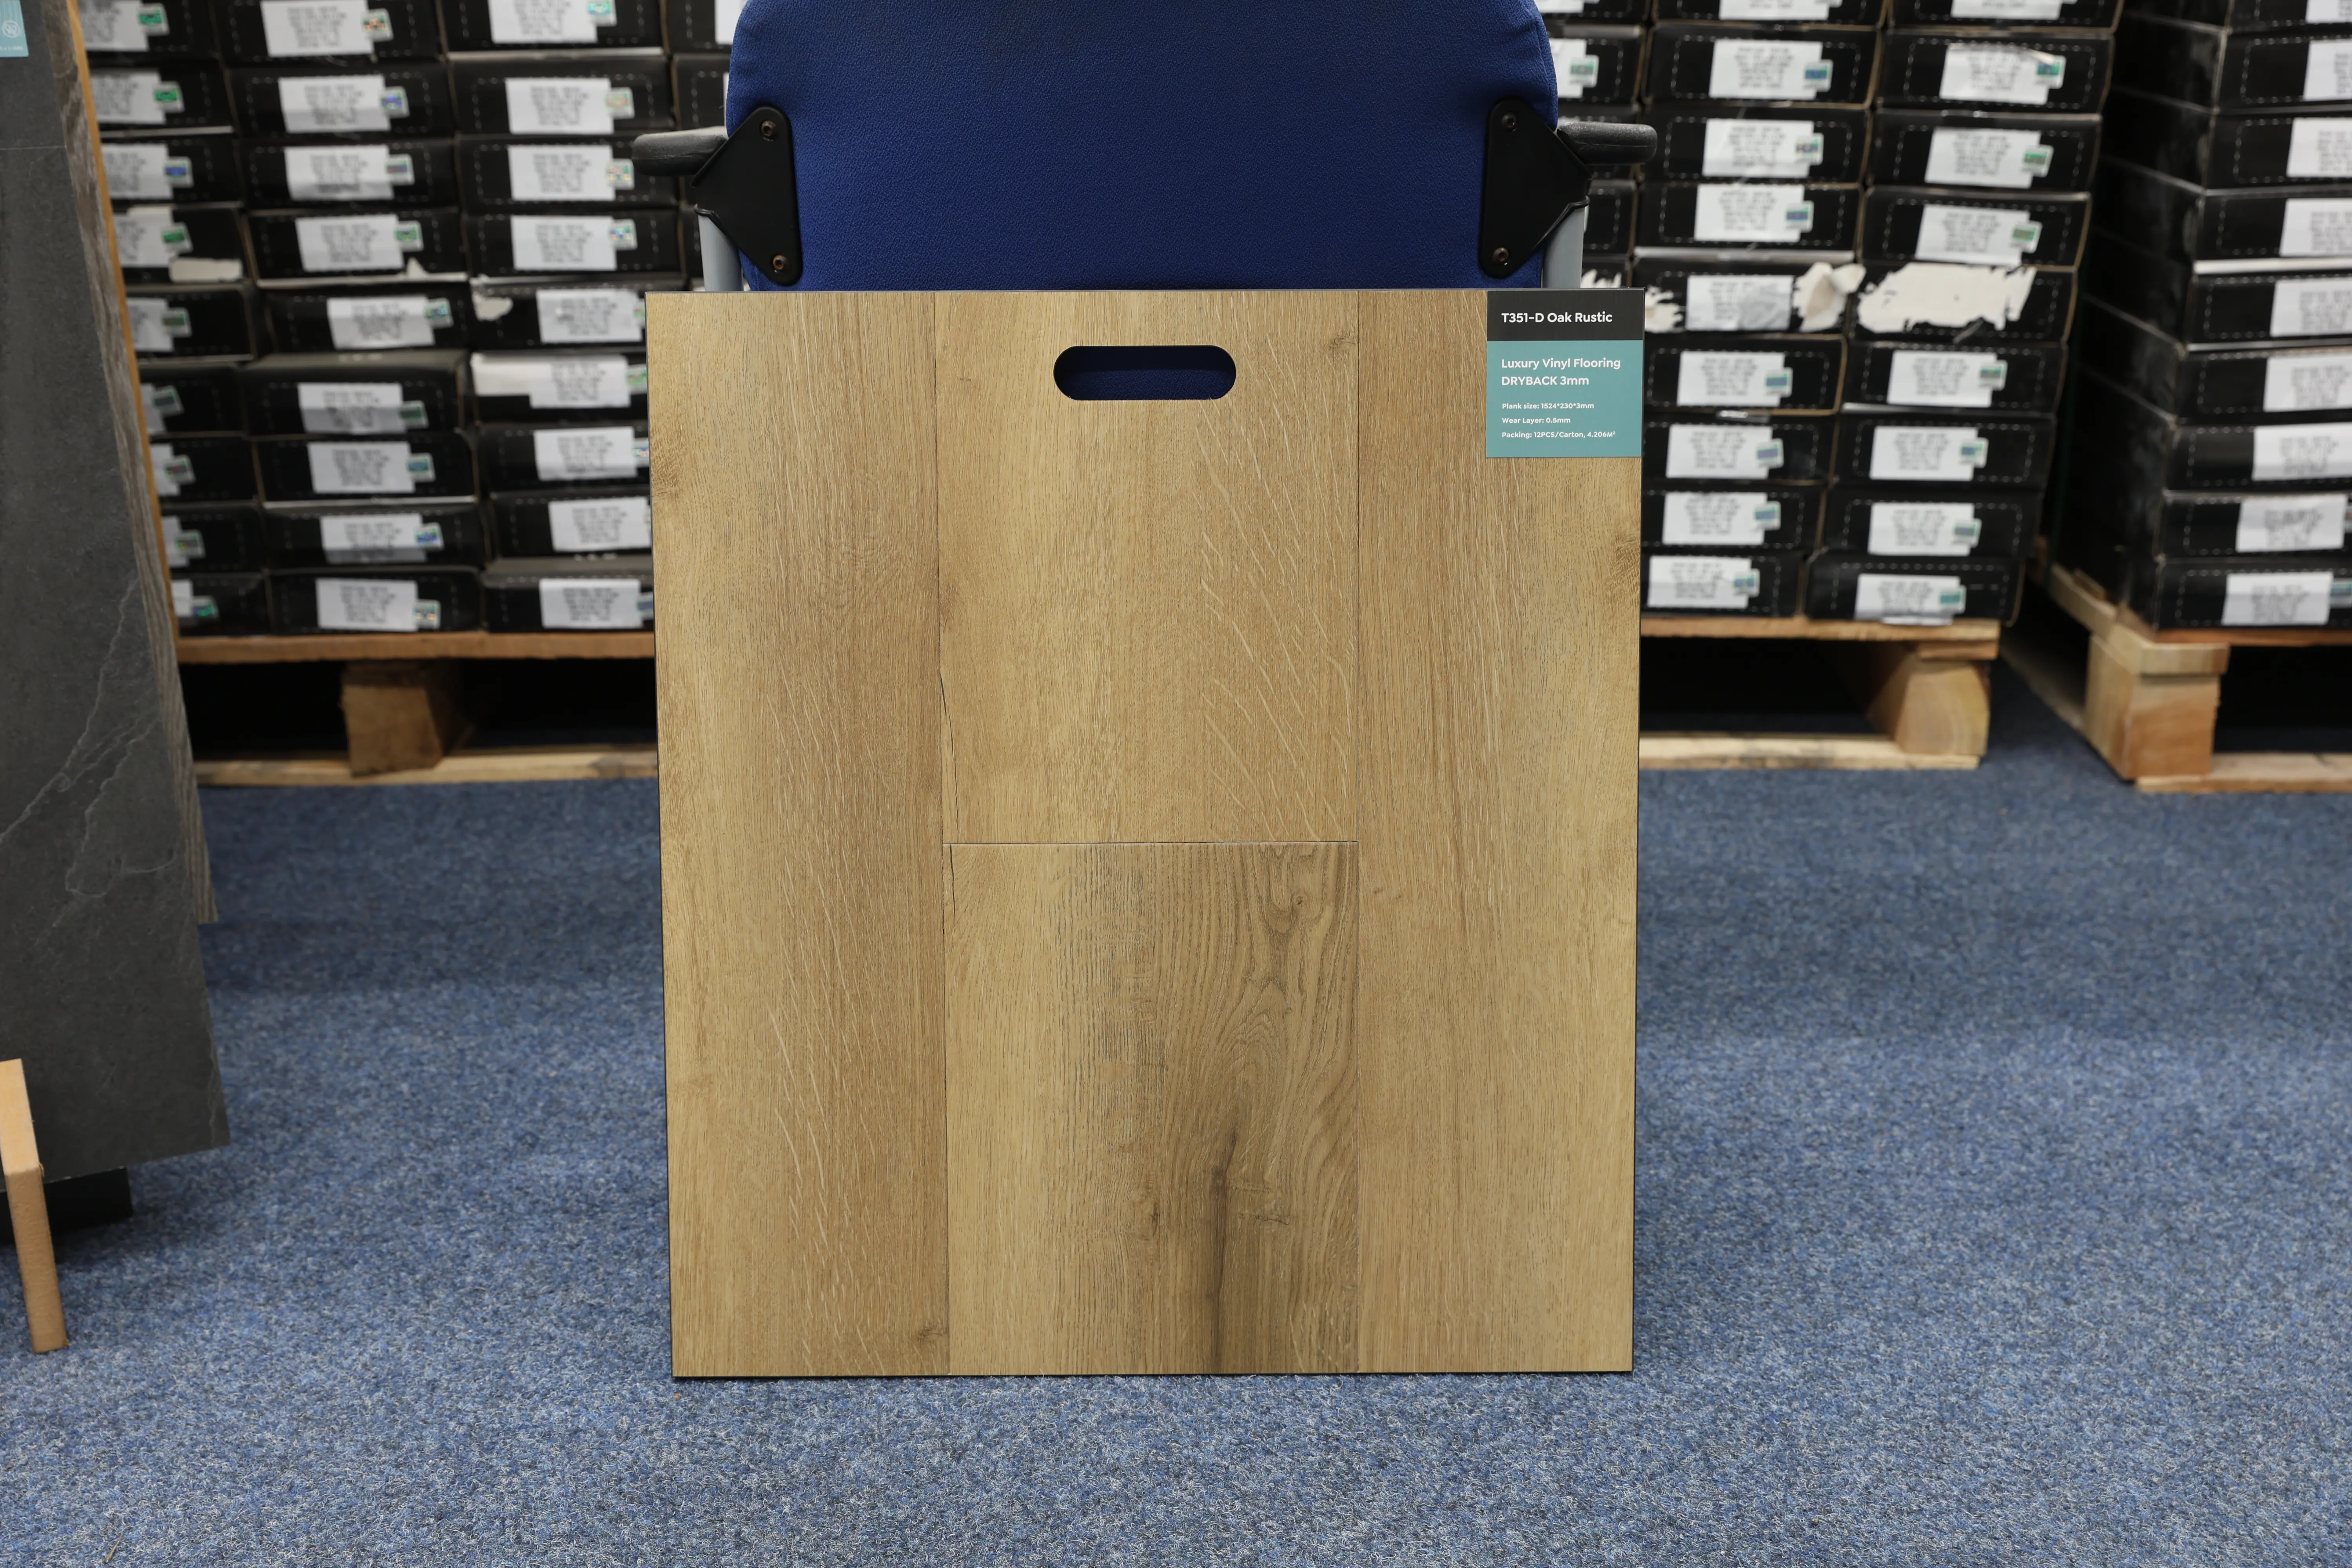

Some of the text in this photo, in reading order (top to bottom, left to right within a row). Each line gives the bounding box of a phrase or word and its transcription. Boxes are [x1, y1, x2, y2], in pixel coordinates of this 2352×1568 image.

[1501, 311, 1613, 323] T351-D Oak Rustic
[1501, 358, 1621, 370] Luxury Vinyl Flooring
[1501, 376, 1589, 385] DRYBACK 3mm
